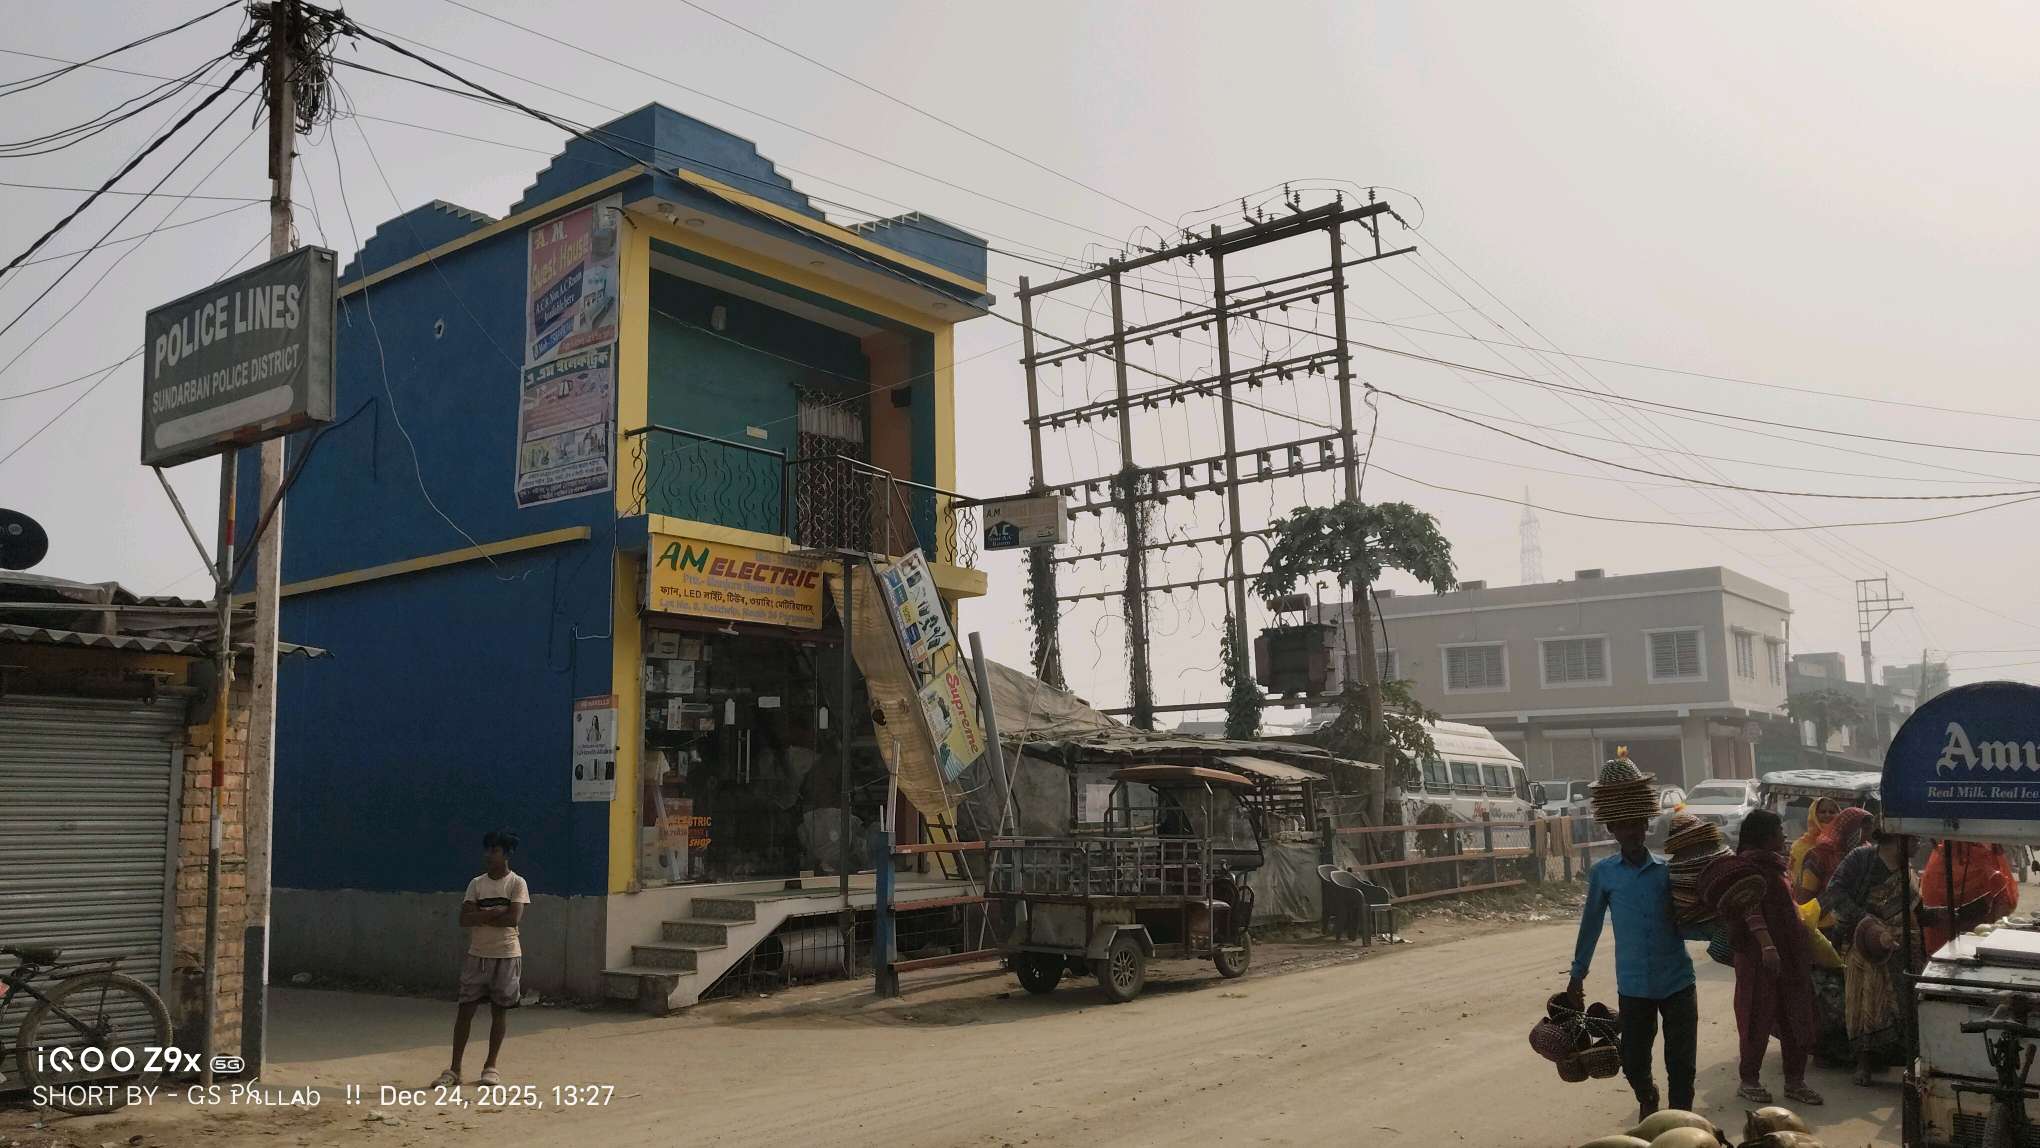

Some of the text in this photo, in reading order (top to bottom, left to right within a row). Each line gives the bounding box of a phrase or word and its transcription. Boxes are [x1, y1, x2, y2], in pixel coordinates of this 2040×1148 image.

[155, 284, 301, 379] POLICE LINES
[152, 344, 299, 414] SUNDARBAN POLICE DISTRICT
[656, 541, 710, 573] AM
[709, 557, 821, 589] ELECTRIC
[684, 589, 702, 599] LED
[944, 672, 979, 755] Supreme
[1928, 786, 2040, 799] Real Milk. Real Ice
